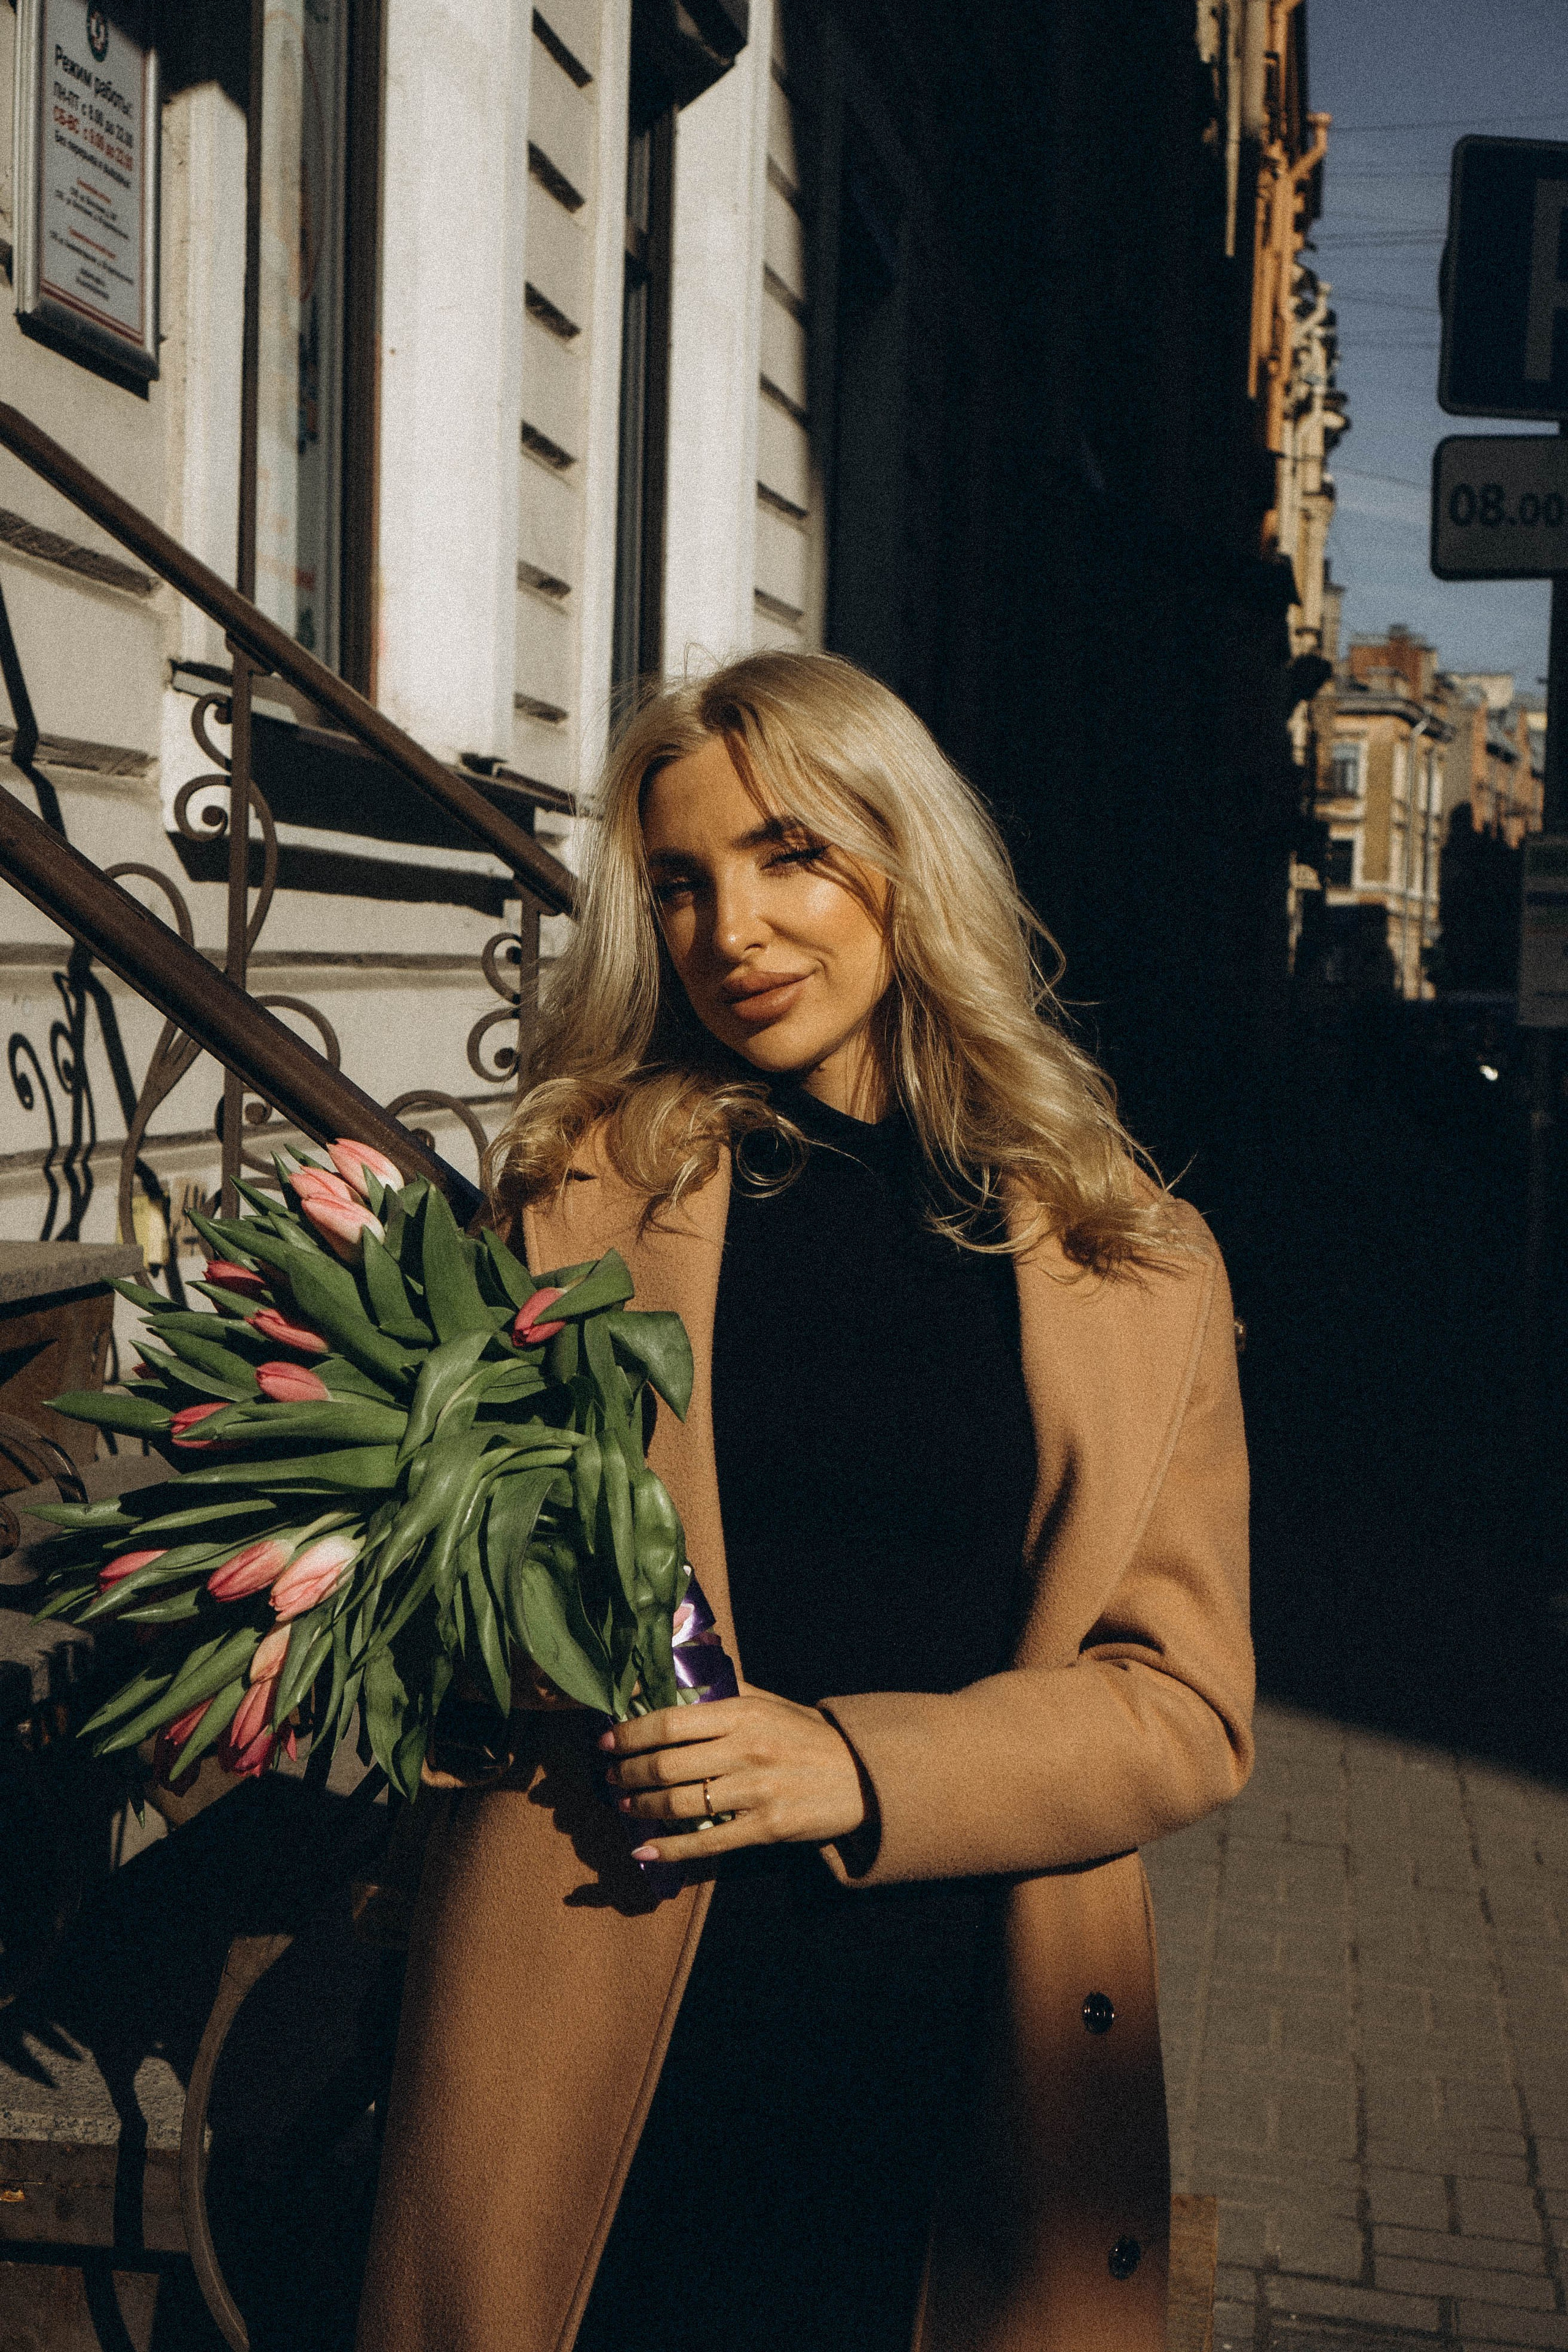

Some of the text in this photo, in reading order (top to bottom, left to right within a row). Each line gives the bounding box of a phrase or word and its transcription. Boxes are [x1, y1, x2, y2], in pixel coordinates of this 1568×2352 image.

[55, 43, 132, 119] Режим работы:
[1449, 483, 1565, 527] 08.00
